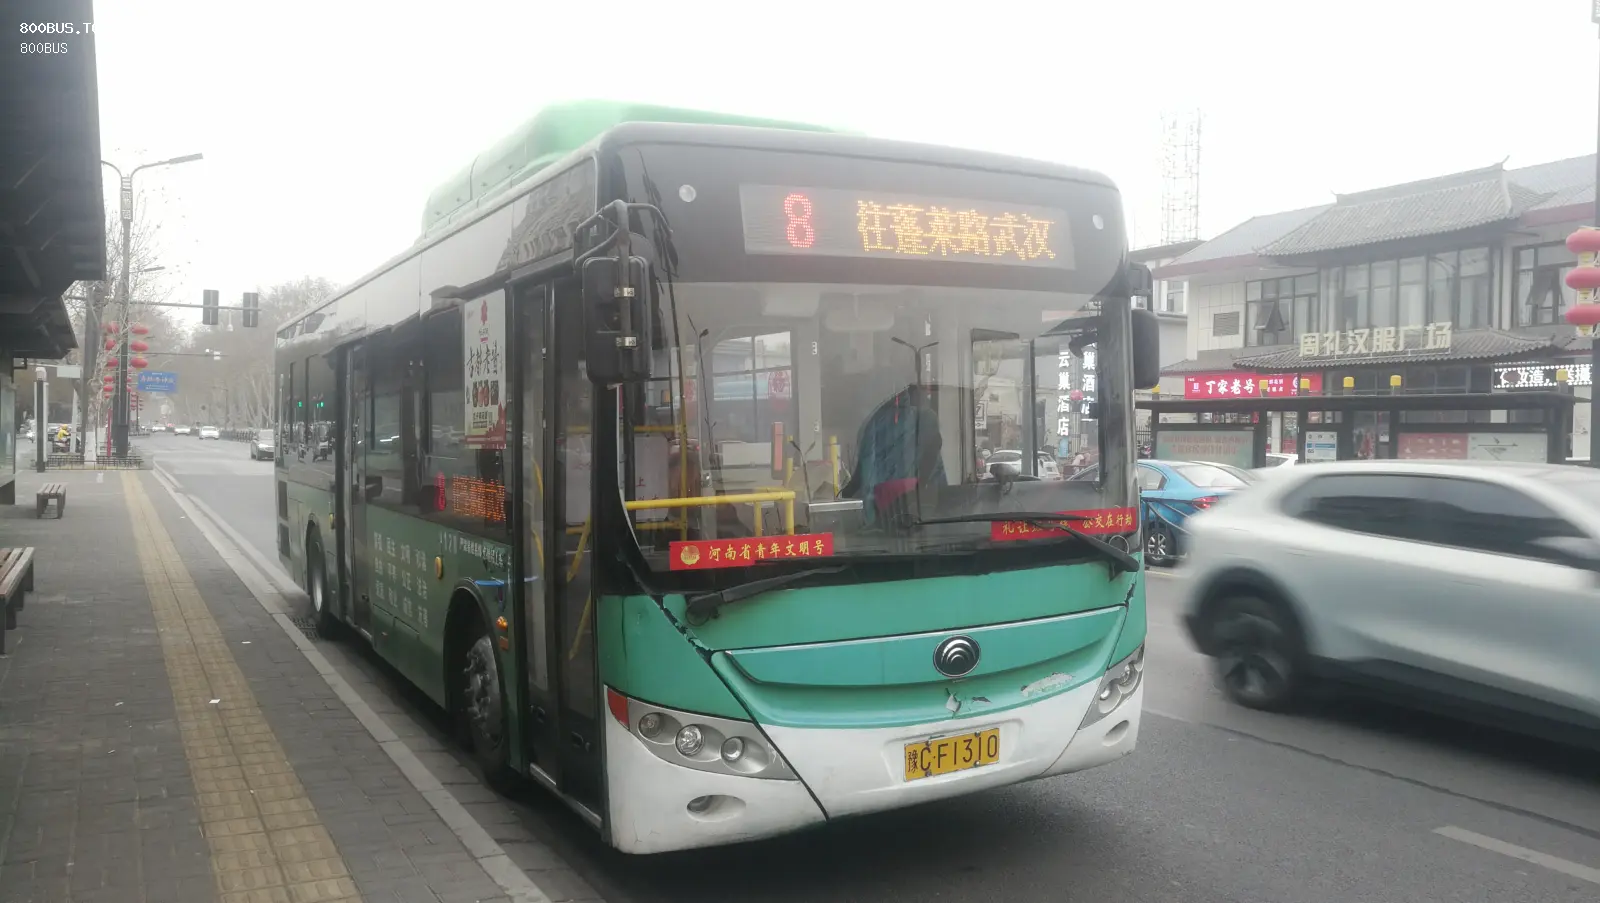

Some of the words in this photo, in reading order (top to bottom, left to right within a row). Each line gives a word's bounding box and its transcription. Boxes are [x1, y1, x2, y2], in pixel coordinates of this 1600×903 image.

[784, 193, 815, 248] 8
[857, 199, 1056, 261] 往蓬莱路武汉
[1299, 321, 1453, 358] 周礼汉服广场
[1056, 351, 1071, 437] 云巢酒店
[1205, 378, 1256, 395] 丁家老号
[708, 539, 825, 562] 河南省青年文明号
